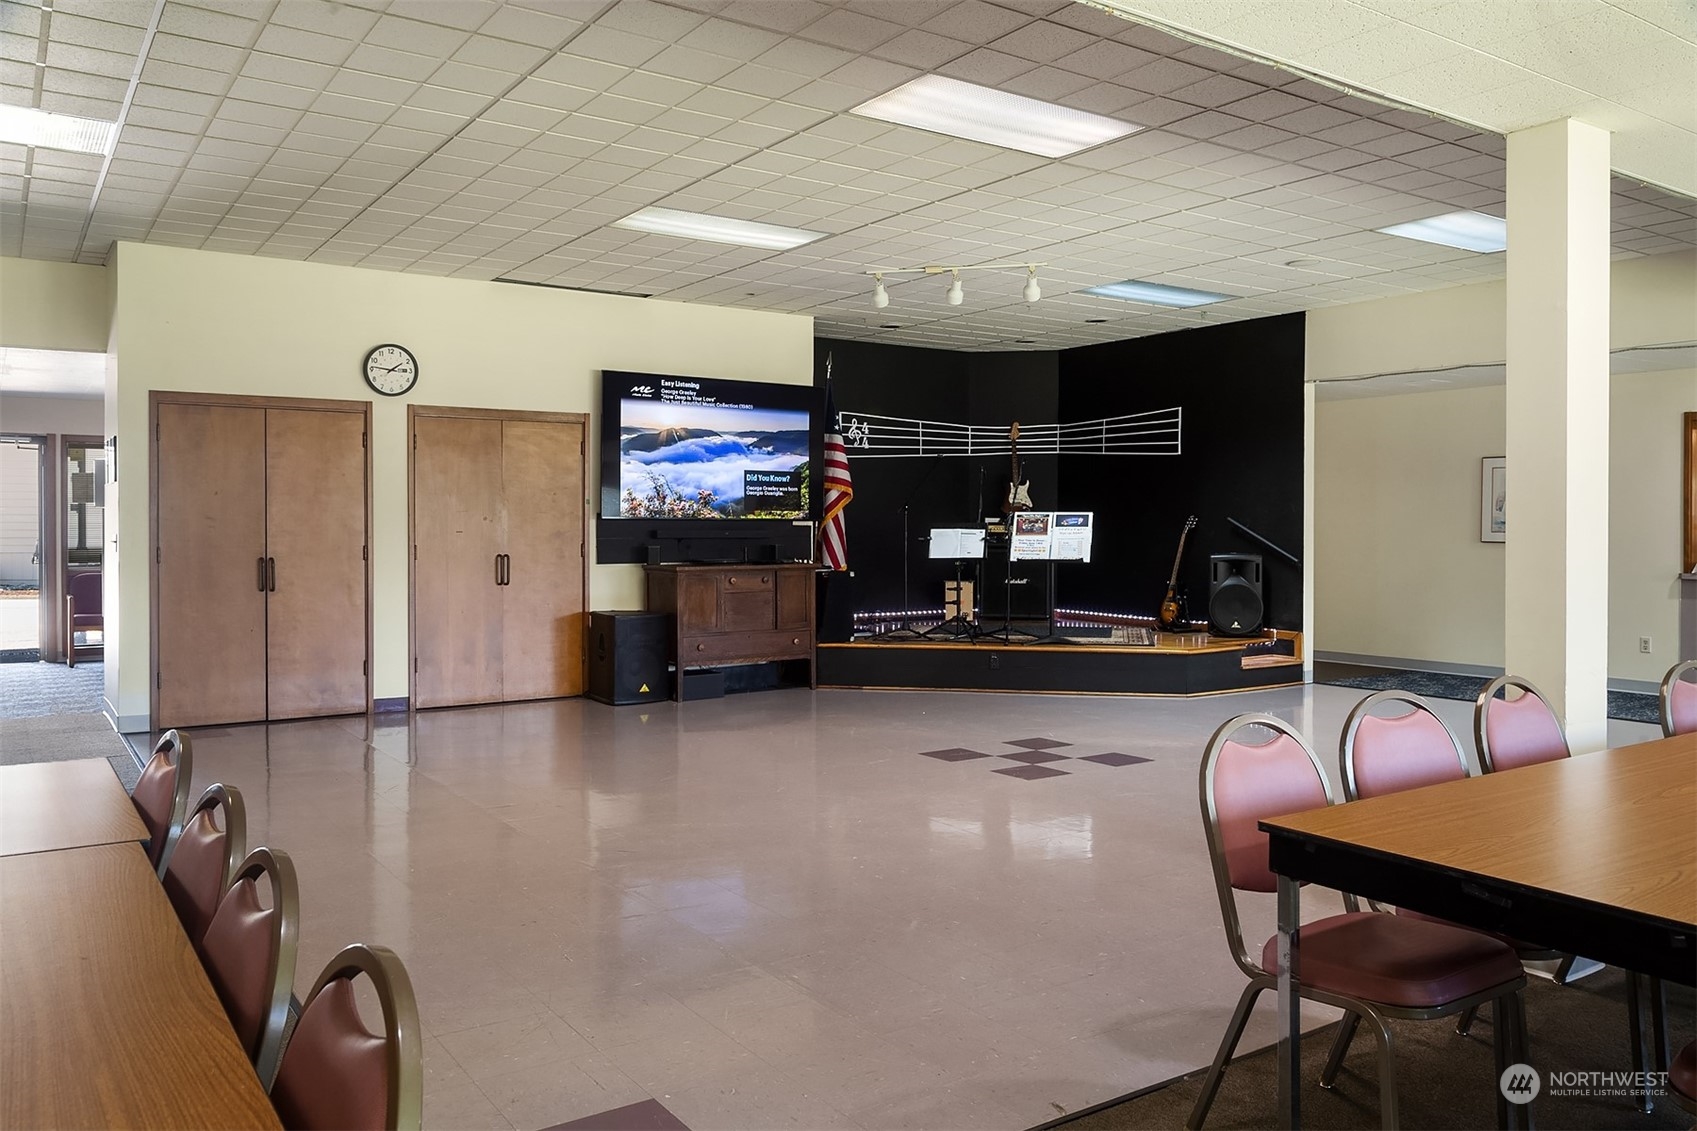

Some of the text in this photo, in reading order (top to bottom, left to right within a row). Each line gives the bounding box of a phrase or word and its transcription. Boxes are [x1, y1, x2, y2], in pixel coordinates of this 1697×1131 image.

[661, 379, 700, 390] Easy Listening
[746, 473, 757, 482] Did
[758, 474, 769, 482] You
